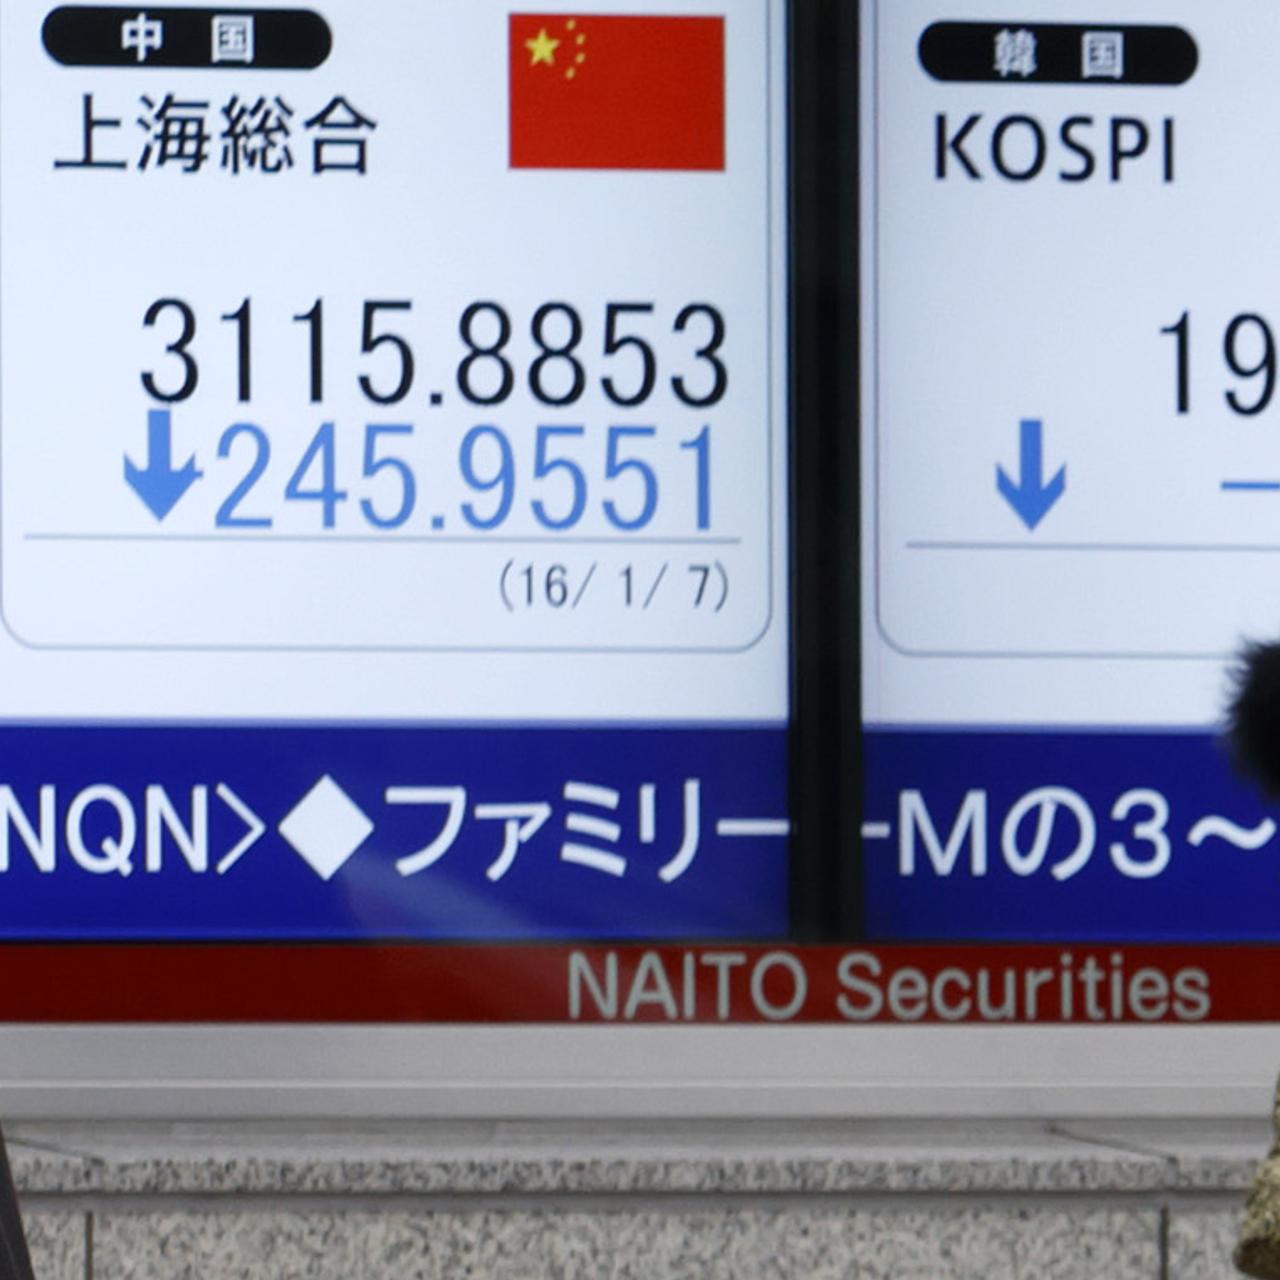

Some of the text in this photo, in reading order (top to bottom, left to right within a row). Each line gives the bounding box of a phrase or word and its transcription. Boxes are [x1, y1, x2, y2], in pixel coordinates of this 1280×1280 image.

[120, 11, 255, 64] 中国
[993, 28, 1125, 80] 韓国
[52, 92, 378, 176] 上海総合
[934, 112, 1175, 184] KOSPI
[140, 297, 729, 410] 3115.8853
[214, 421, 711, 532] 245.9551
[499, 560, 730, 613] (16/ 1/ 7)
[567, 950, 1212, 1022] NAITO Securities
